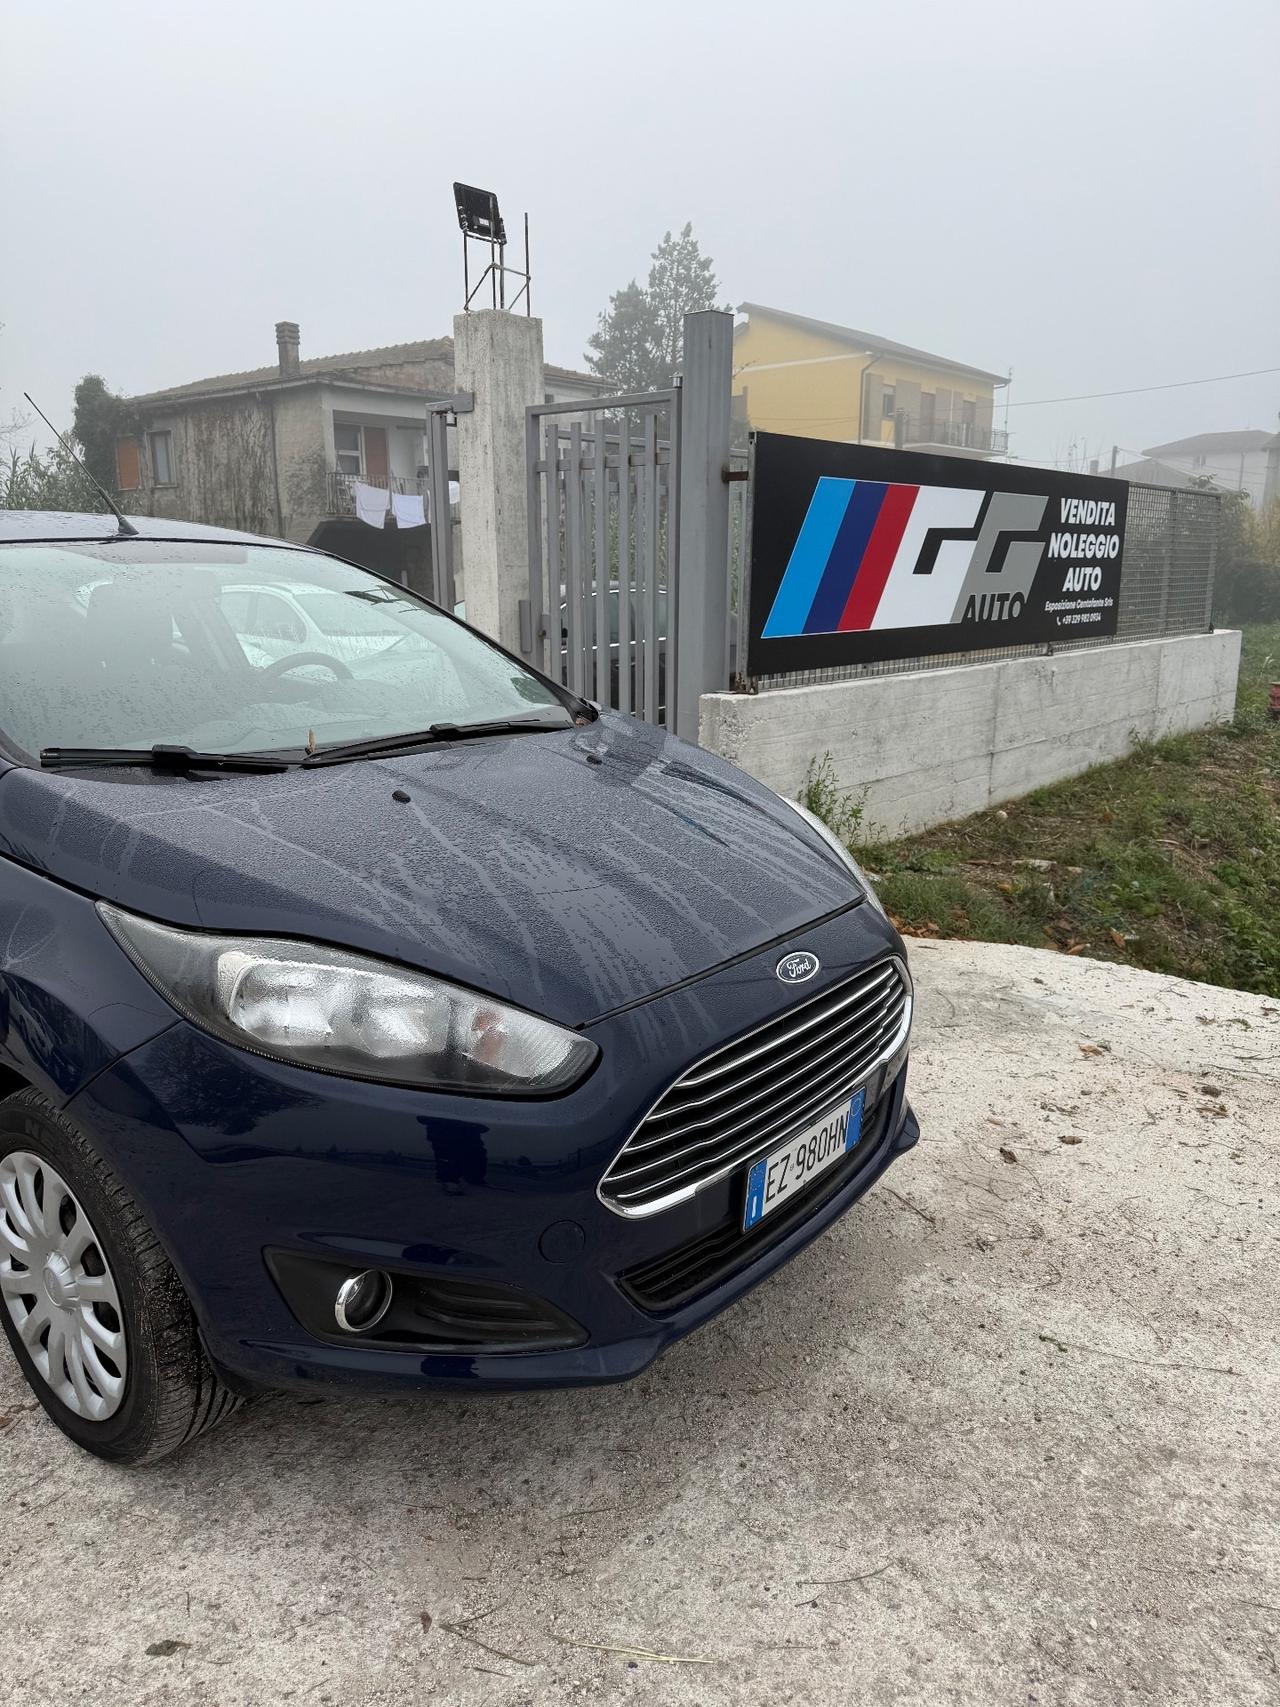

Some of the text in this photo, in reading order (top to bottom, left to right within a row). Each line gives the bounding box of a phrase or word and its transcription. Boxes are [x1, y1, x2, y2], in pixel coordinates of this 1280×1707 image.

[1060, 497, 1116, 526] VENDITA
[1047, 532, 1120, 559] NOLEGGIO
[1061, 566, 1102, 592] AUTO
[963, 591, 1027, 623] AUTO
[1044, 600, 1076, 613] Esposizione
[1062, 614, 1071, 624] +39
[786, 958, 811, 978] Ford
[765, 1152, 791, 1204] EZ
